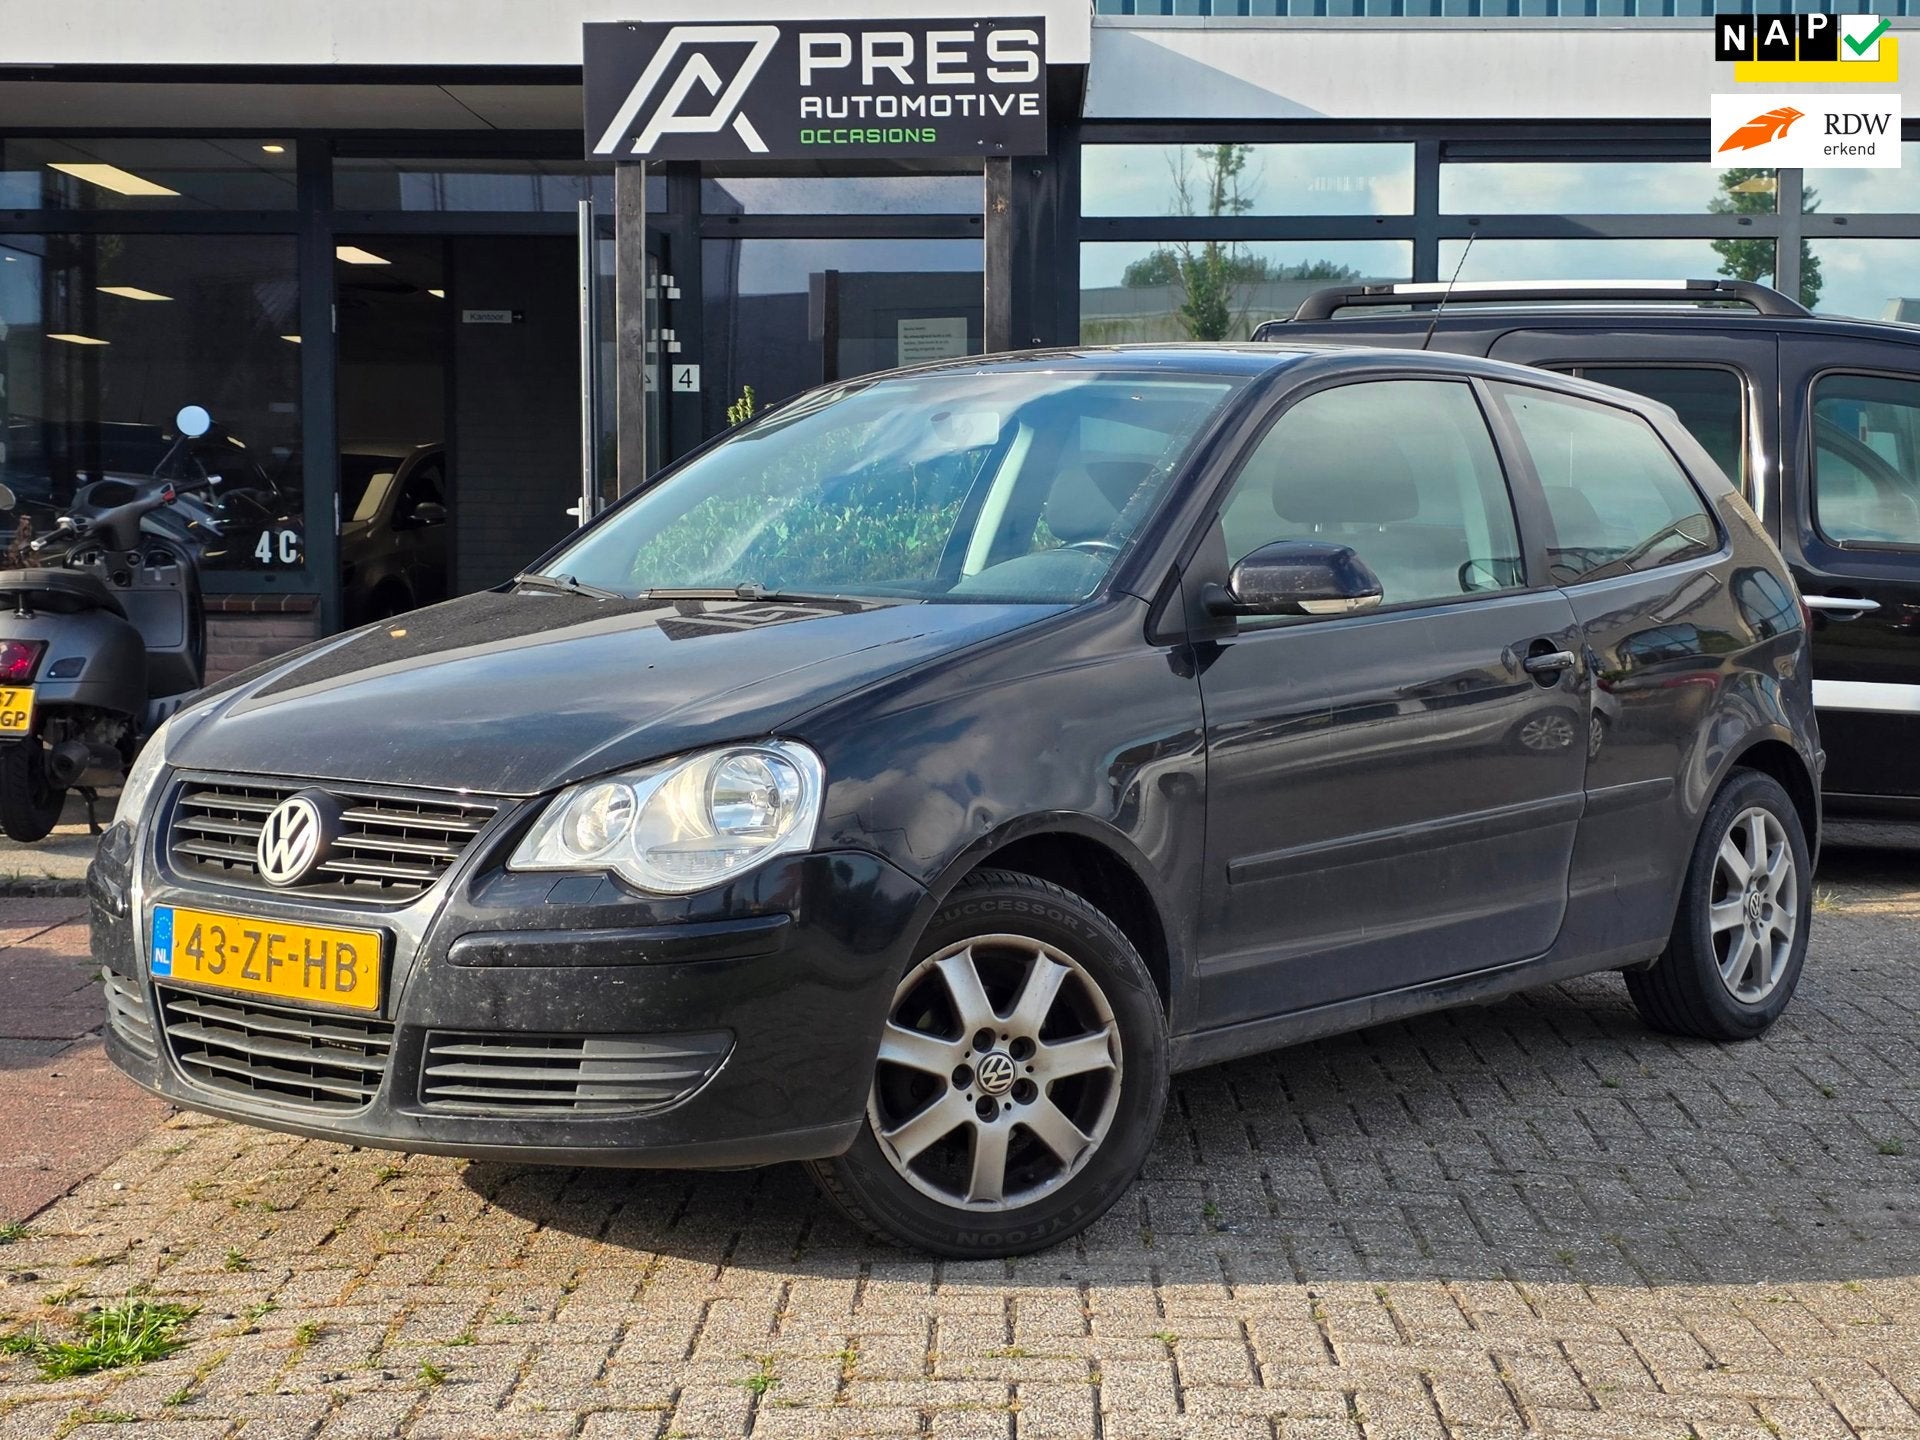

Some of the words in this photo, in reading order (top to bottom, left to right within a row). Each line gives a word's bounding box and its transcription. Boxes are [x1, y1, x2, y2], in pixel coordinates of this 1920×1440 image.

[799, 29, 1040, 87] PRES
[800, 92, 1040, 119] AUTOMOTIVE
[800, 127, 937, 145] OCCASIONS
[678, 367, 693, 389] 4
[930, 900, 1079, 929] SUCCESSOR
[155, 947, 170, 965] NL
[184, 922, 358, 993] 43-ZF-HB
[956, 1204, 1089, 1247] TYFOON
